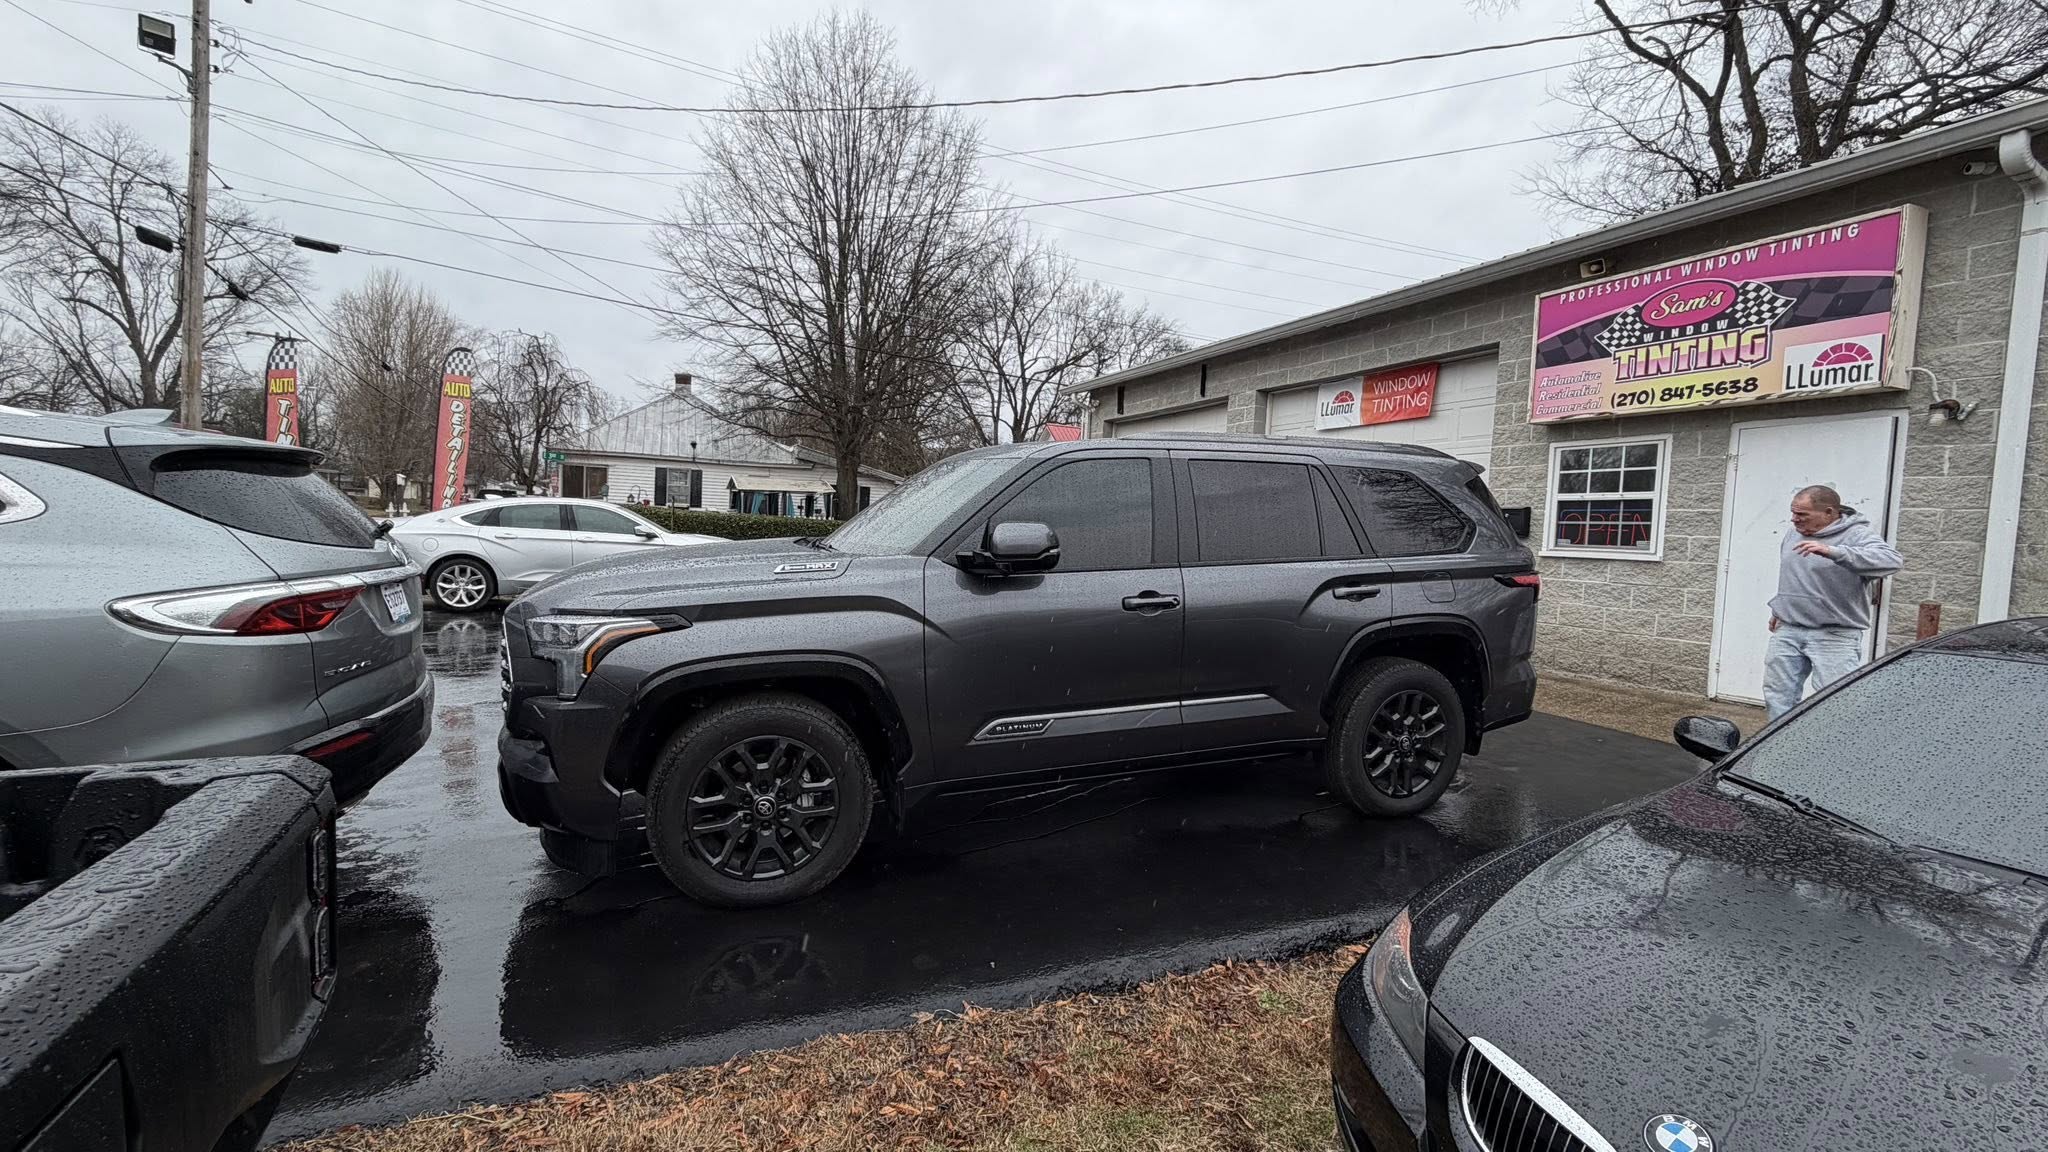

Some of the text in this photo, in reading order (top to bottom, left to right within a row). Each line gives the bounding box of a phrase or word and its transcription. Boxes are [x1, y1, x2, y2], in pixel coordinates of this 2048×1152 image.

[1559, 223, 1860, 305] PROFESSIONAL WINDOW TINTING
[1650, 289, 1726, 320] Sam's
[1643, 319, 1729, 343] WINDOW
[1612, 325, 1771, 382] TINTING
[269, 377, 295, 394] AUTO
[1373, 372, 1431, 395] WINDOW
[1539, 370, 1601, 389] Automotive
[1785, 362, 1875, 390] LLumar
[444, 381, 471, 398] AUTO
[1538, 383, 1602, 402] Residential
[1611, 376, 1759, 409] (270) 847-5638
[1321, 402, 1355, 417] LLumar
[1372, 391, 1428, 415] TINTING
[1535, 397, 1602, 416] Commercial
[1561, 513, 1651, 546] OPEN
[806, 562, 834, 570] MAX
[995, 723, 1044, 732] PLATINUM
[1661, 1115, 1710, 1149] BMW
